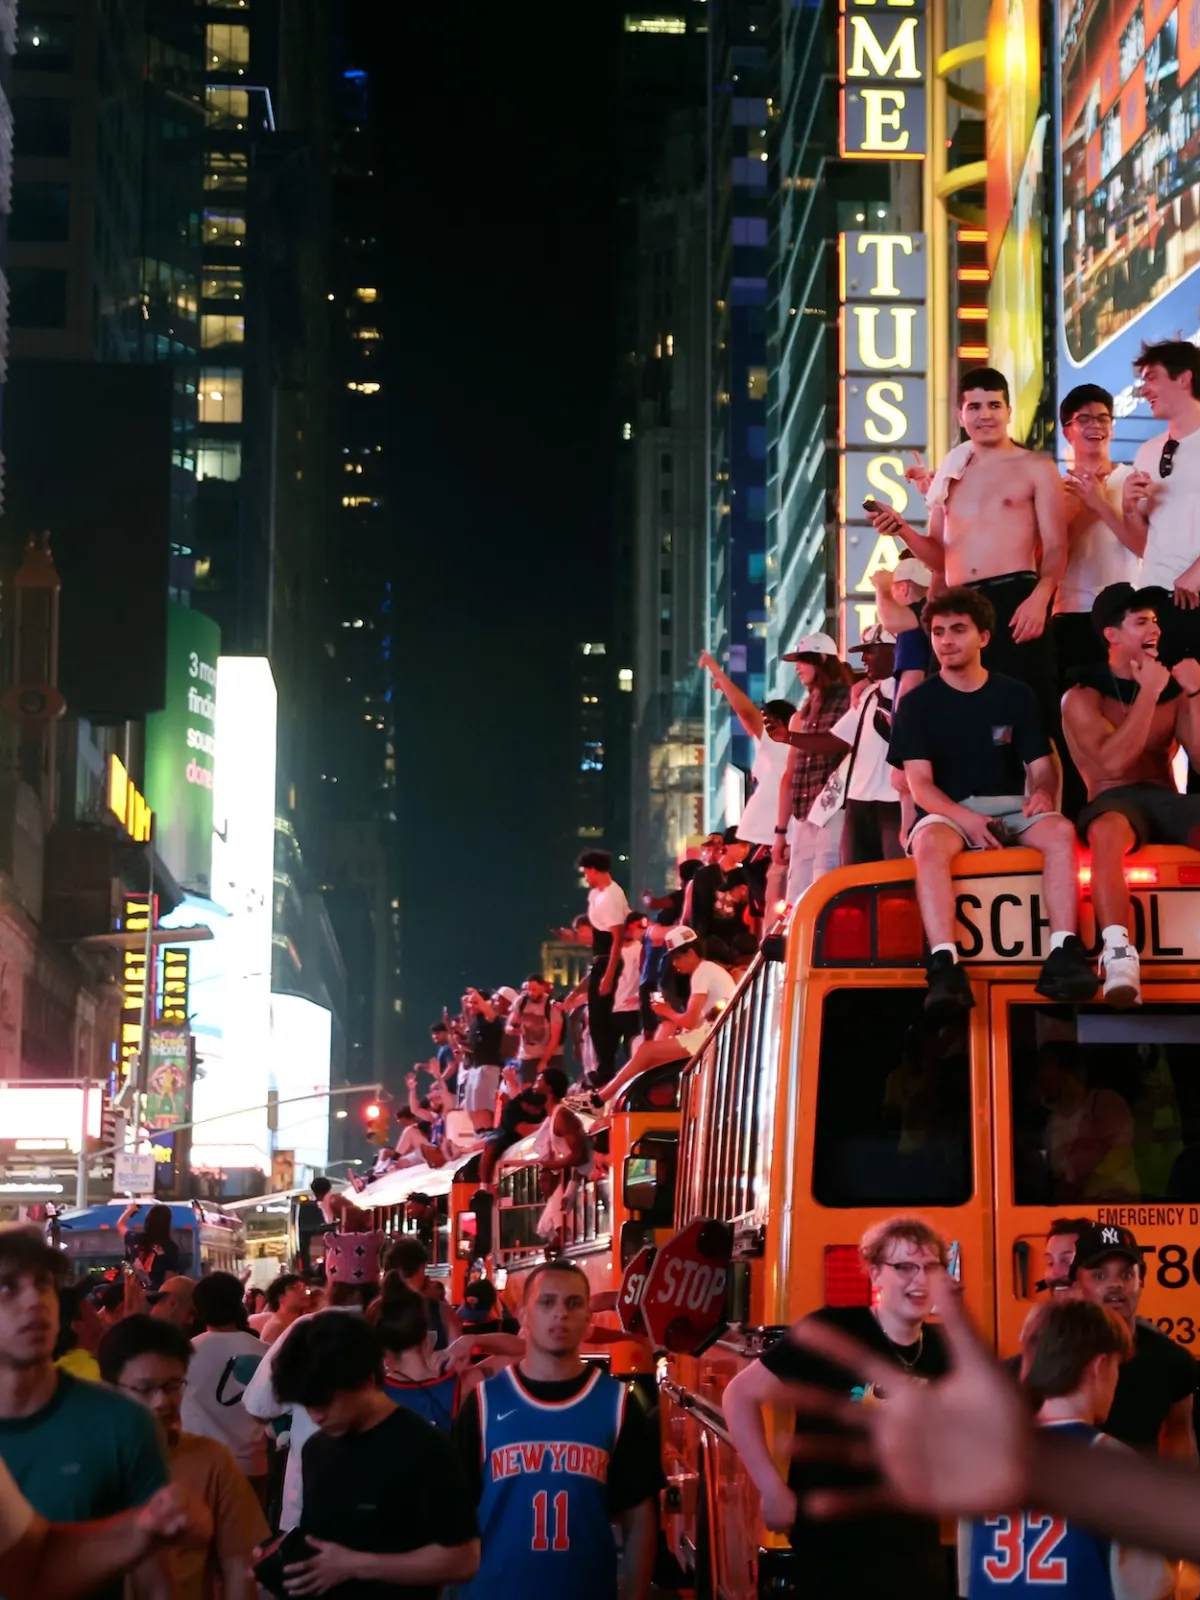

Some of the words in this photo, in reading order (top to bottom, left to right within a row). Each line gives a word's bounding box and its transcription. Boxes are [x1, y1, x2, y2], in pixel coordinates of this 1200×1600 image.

[847, 0, 922, 151] ME
[123, 901, 151, 1010] VICTRY
[1097, 1207, 1185, 1227] EMERGENCY
[624, 1273, 647, 1306] ST
[657, 1258, 727, 1314] STOP
[491, 1442, 547, 1483] NEW
[549, 1442, 611, 1485] YORK
[531, 1490, 570, 1551] 11
[983, 1508, 1068, 1585] 32
